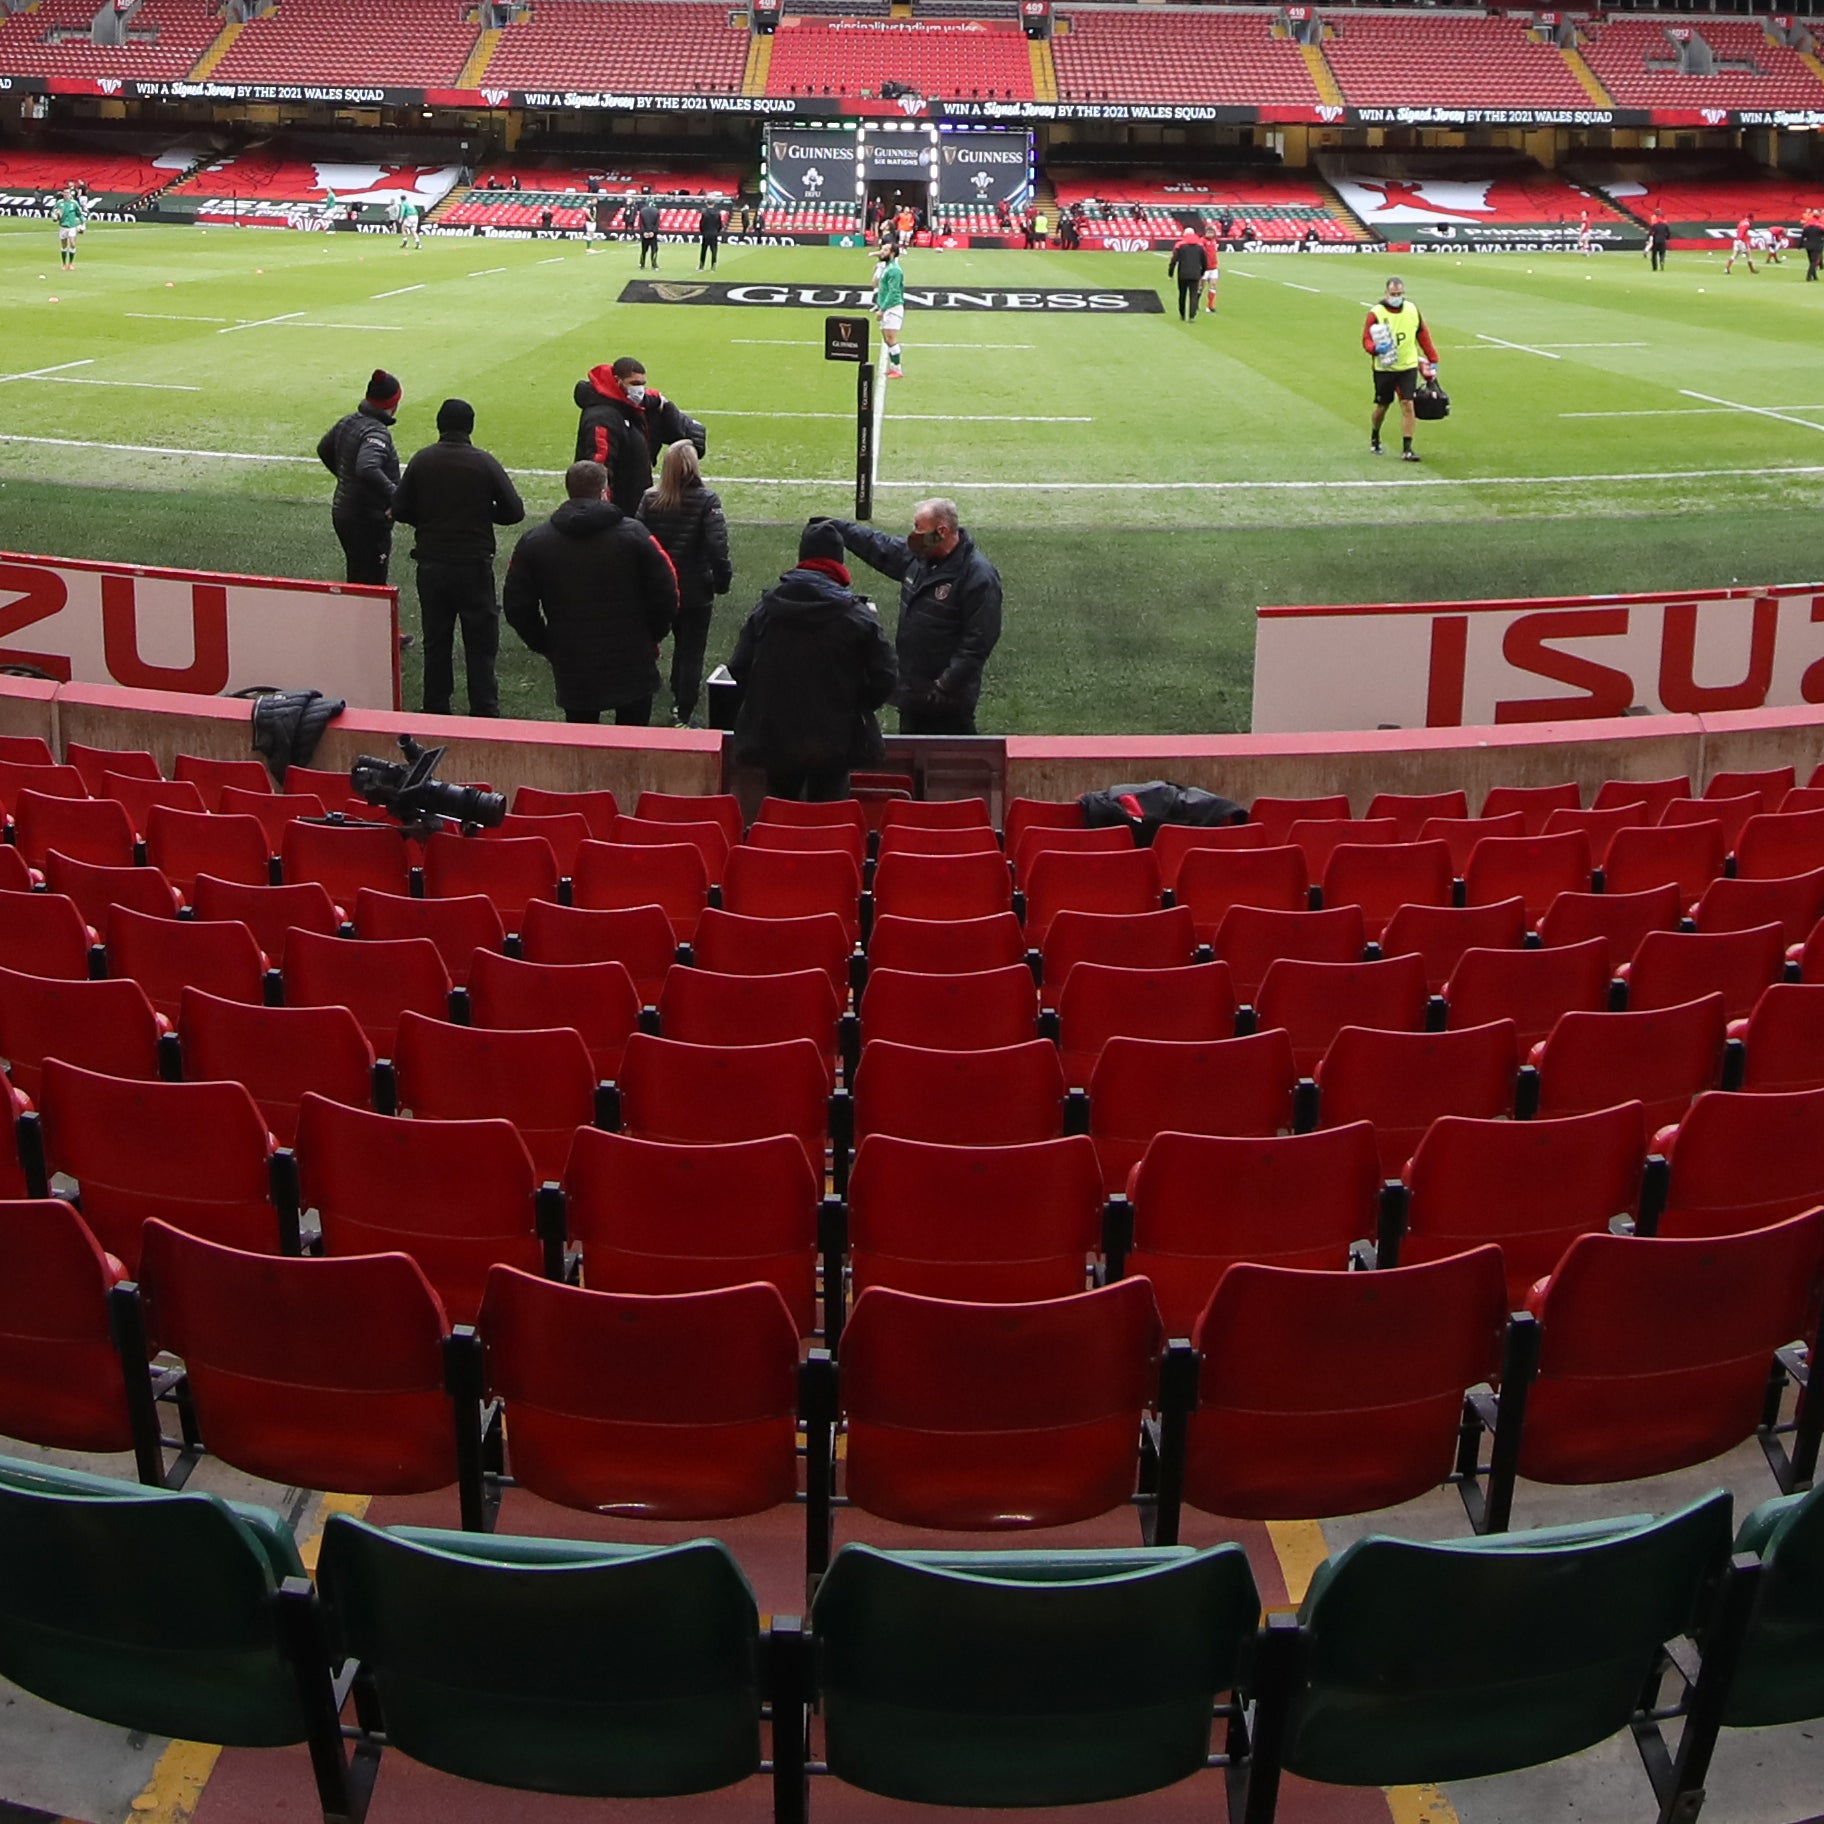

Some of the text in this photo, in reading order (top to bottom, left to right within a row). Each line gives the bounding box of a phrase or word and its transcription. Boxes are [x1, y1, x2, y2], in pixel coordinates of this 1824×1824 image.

[1026, 2, 1043, 11] 409
[1289, 8, 1305, 16] 410
[943, 102, 1215, 120] WIN A Signed Jersey BY THE 2021 WALES SQUAD
[788, 145, 854, 160] GUINNESS
[874, 147, 919, 158] GUINNESS
[958, 149, 1023, 164] GUINNESS
[874, 158, 918, 166] SIX NATIONS
[421, 224, 475, 237] Signed
[1243, 241, 1299, 254] Signed
[726, 285, 1131, 311] GUINNESS
